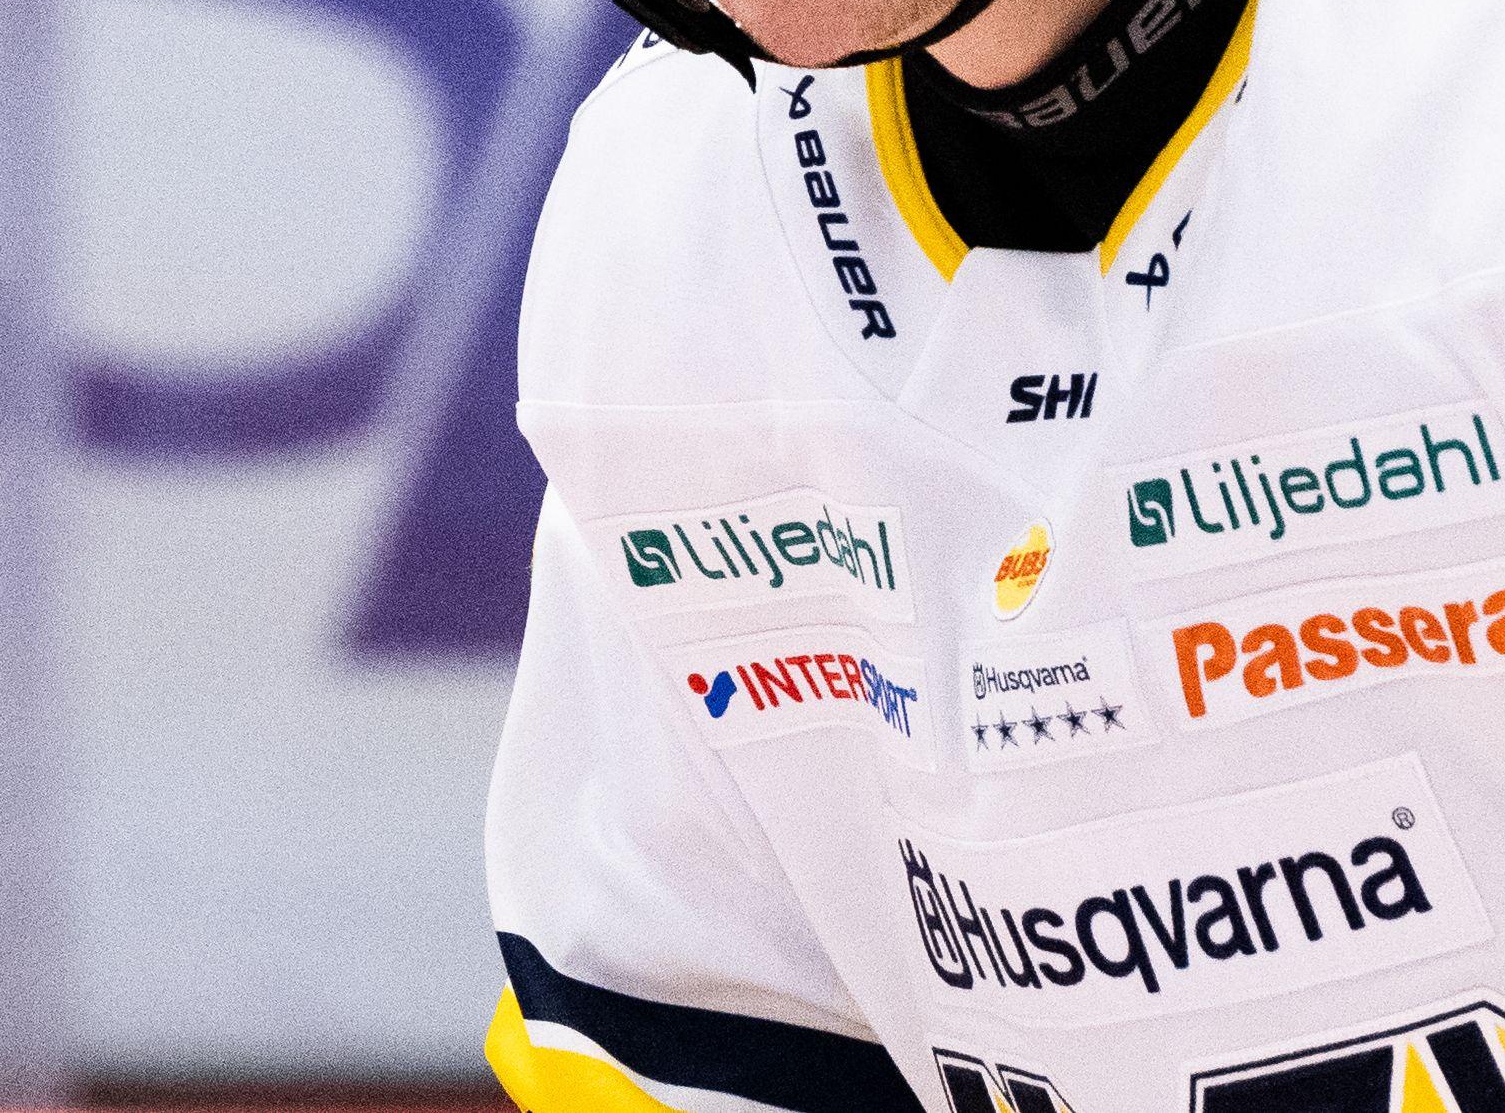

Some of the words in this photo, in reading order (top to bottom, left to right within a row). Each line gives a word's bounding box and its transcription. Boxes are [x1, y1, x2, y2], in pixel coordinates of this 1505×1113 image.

[795, 129, 896, 340] BAUER
[1180, 413, 1501, 541] Liljedahl
[672, 503, 896, 591] Liljedahl
[984, 660, 1091, 694] Husqvarna
[939, 835, 1433, 994] Husqvarna
